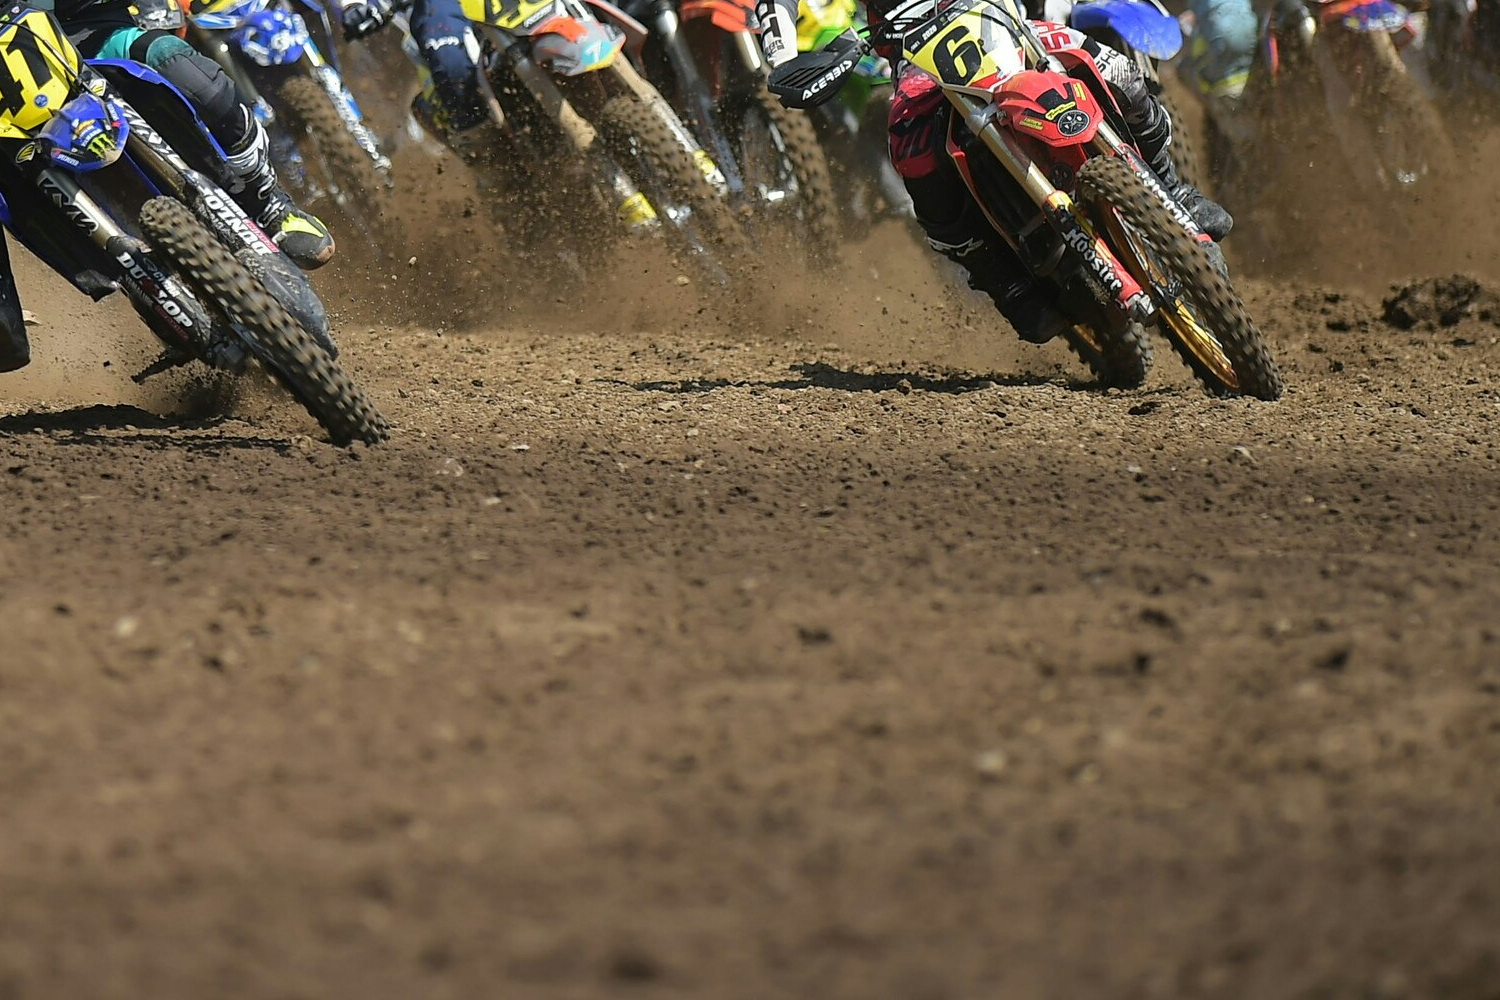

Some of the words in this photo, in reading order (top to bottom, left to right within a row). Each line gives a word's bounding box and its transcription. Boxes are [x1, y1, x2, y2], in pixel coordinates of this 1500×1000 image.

[802, 60, 853, 101] ACERBIS
[115, 251, 194, 328] DULOP
[1062, 227, 1123, 291] Hoosier
